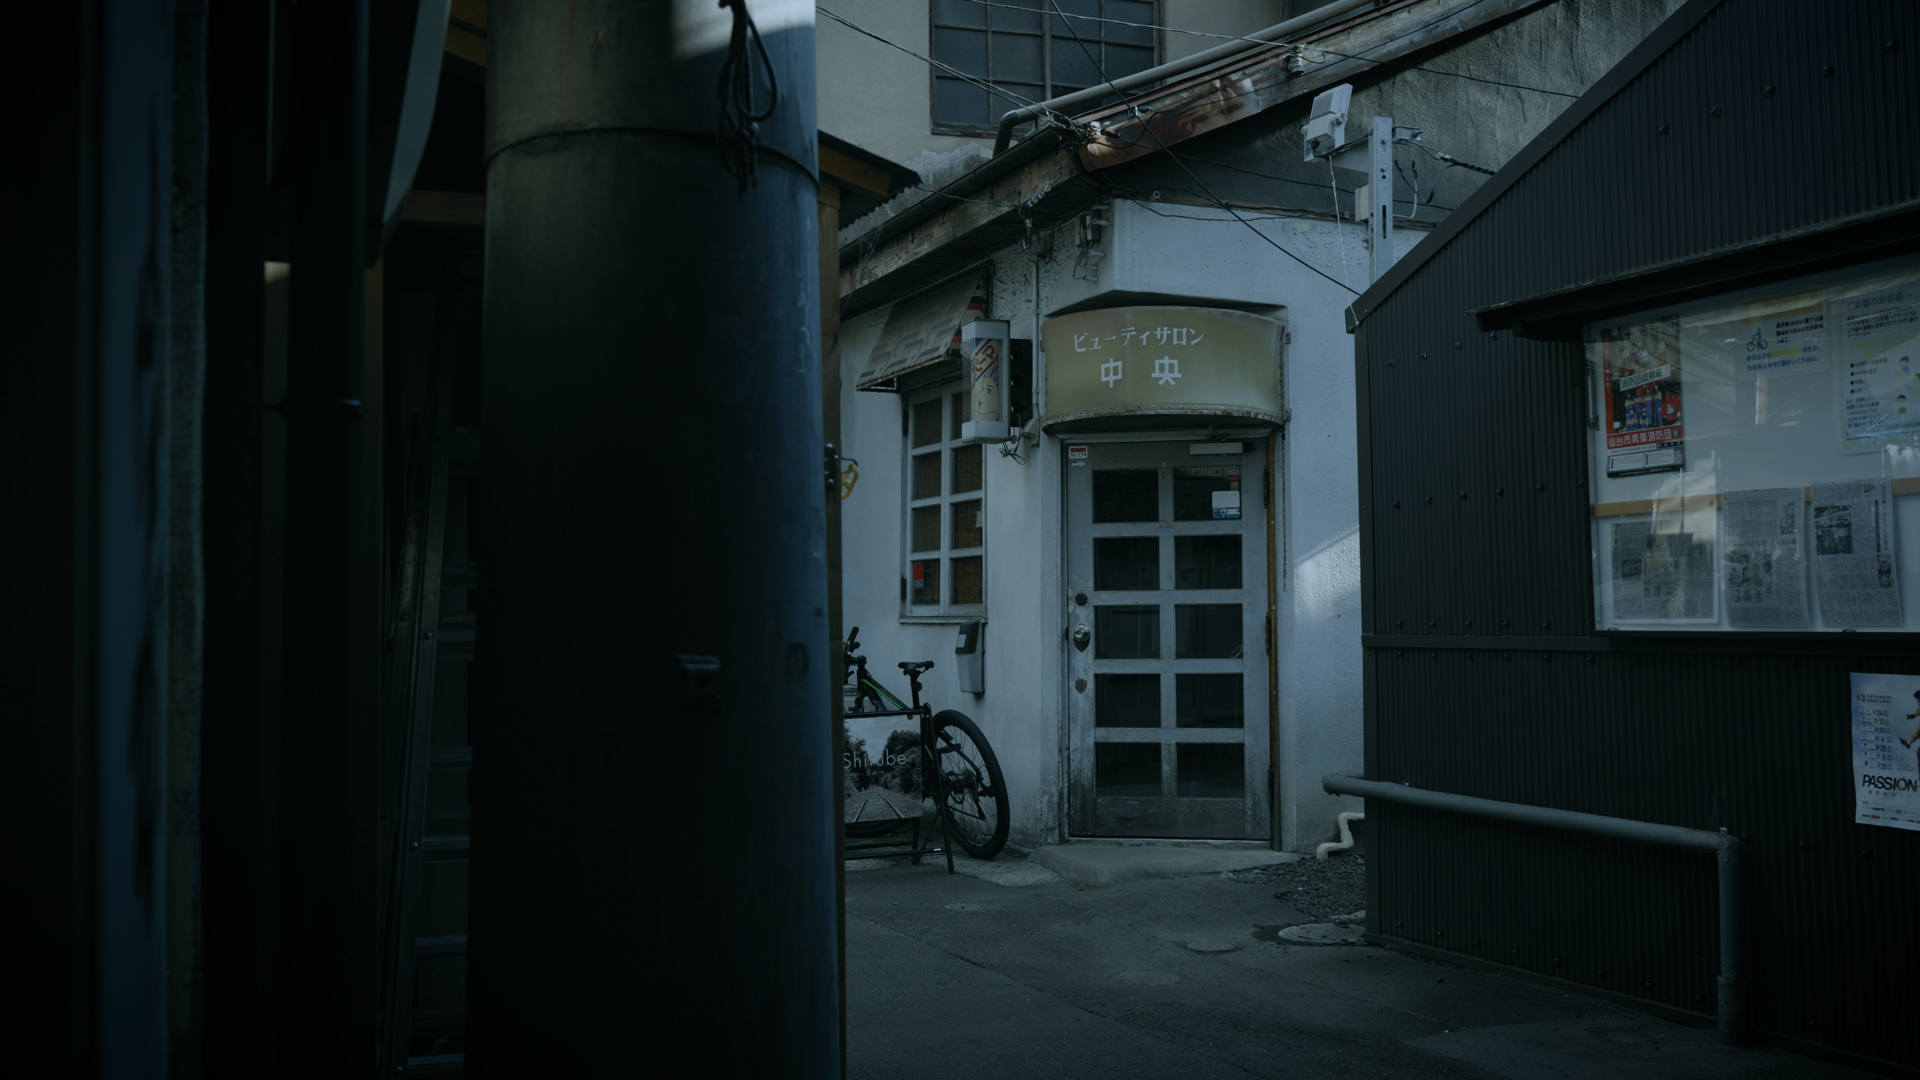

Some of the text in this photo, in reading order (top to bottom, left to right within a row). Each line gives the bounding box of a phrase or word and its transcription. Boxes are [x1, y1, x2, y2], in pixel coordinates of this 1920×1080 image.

[1073, 326, 1205, 352] ビューティサロン
[1100, 355, 1182, 389] 中央
[1608, 428, 1672, 447] 仙台市青葉消防団
[1862, 774, 1918, 793] PASSION
